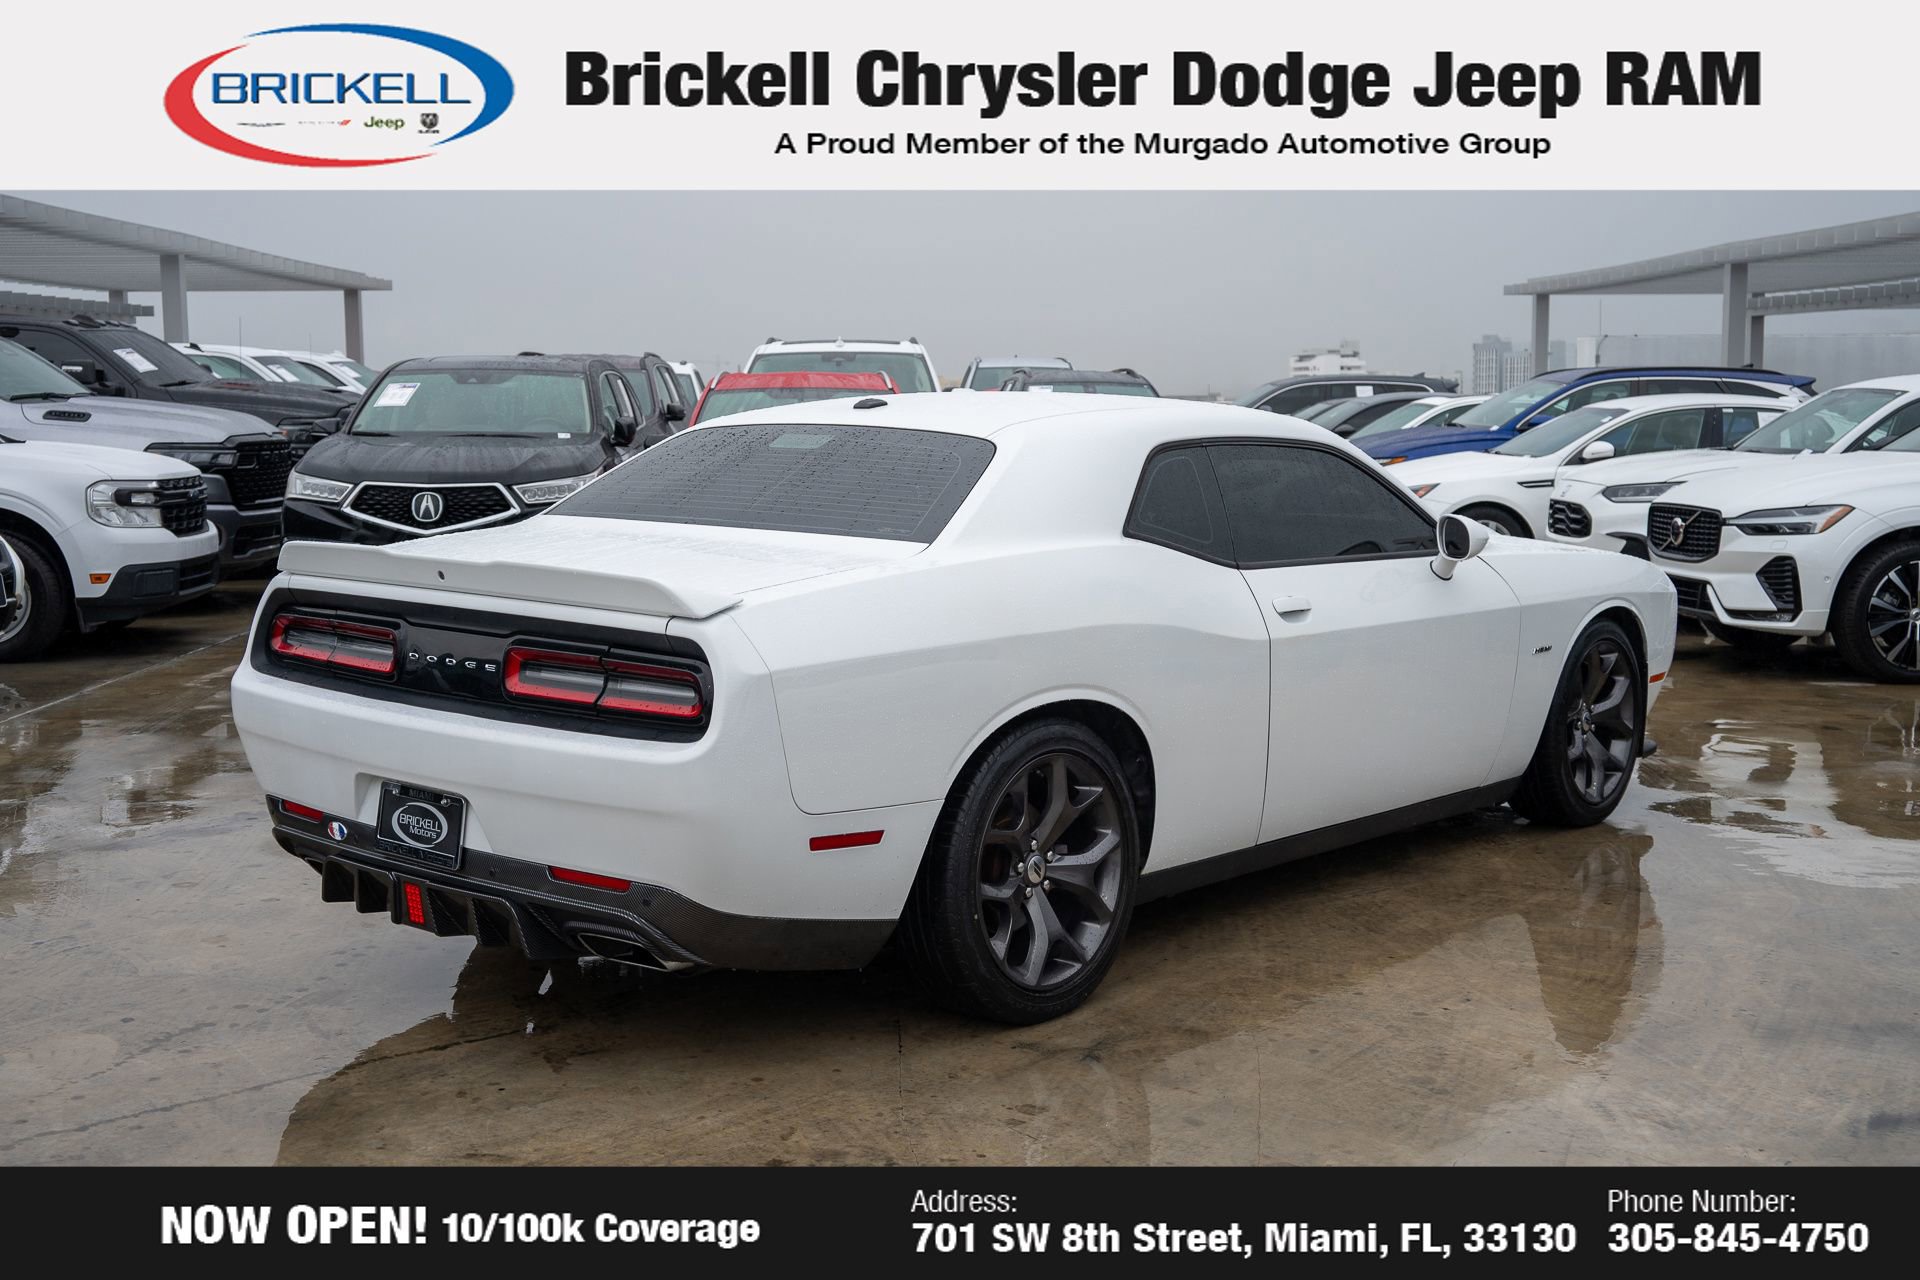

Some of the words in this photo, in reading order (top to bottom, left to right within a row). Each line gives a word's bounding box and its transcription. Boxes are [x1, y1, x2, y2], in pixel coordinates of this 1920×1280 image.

[408, 652, 497, 671] DODGE
[399, 813, 441, 832] BRICKELL
[409, 825, 437, 839] Motors
